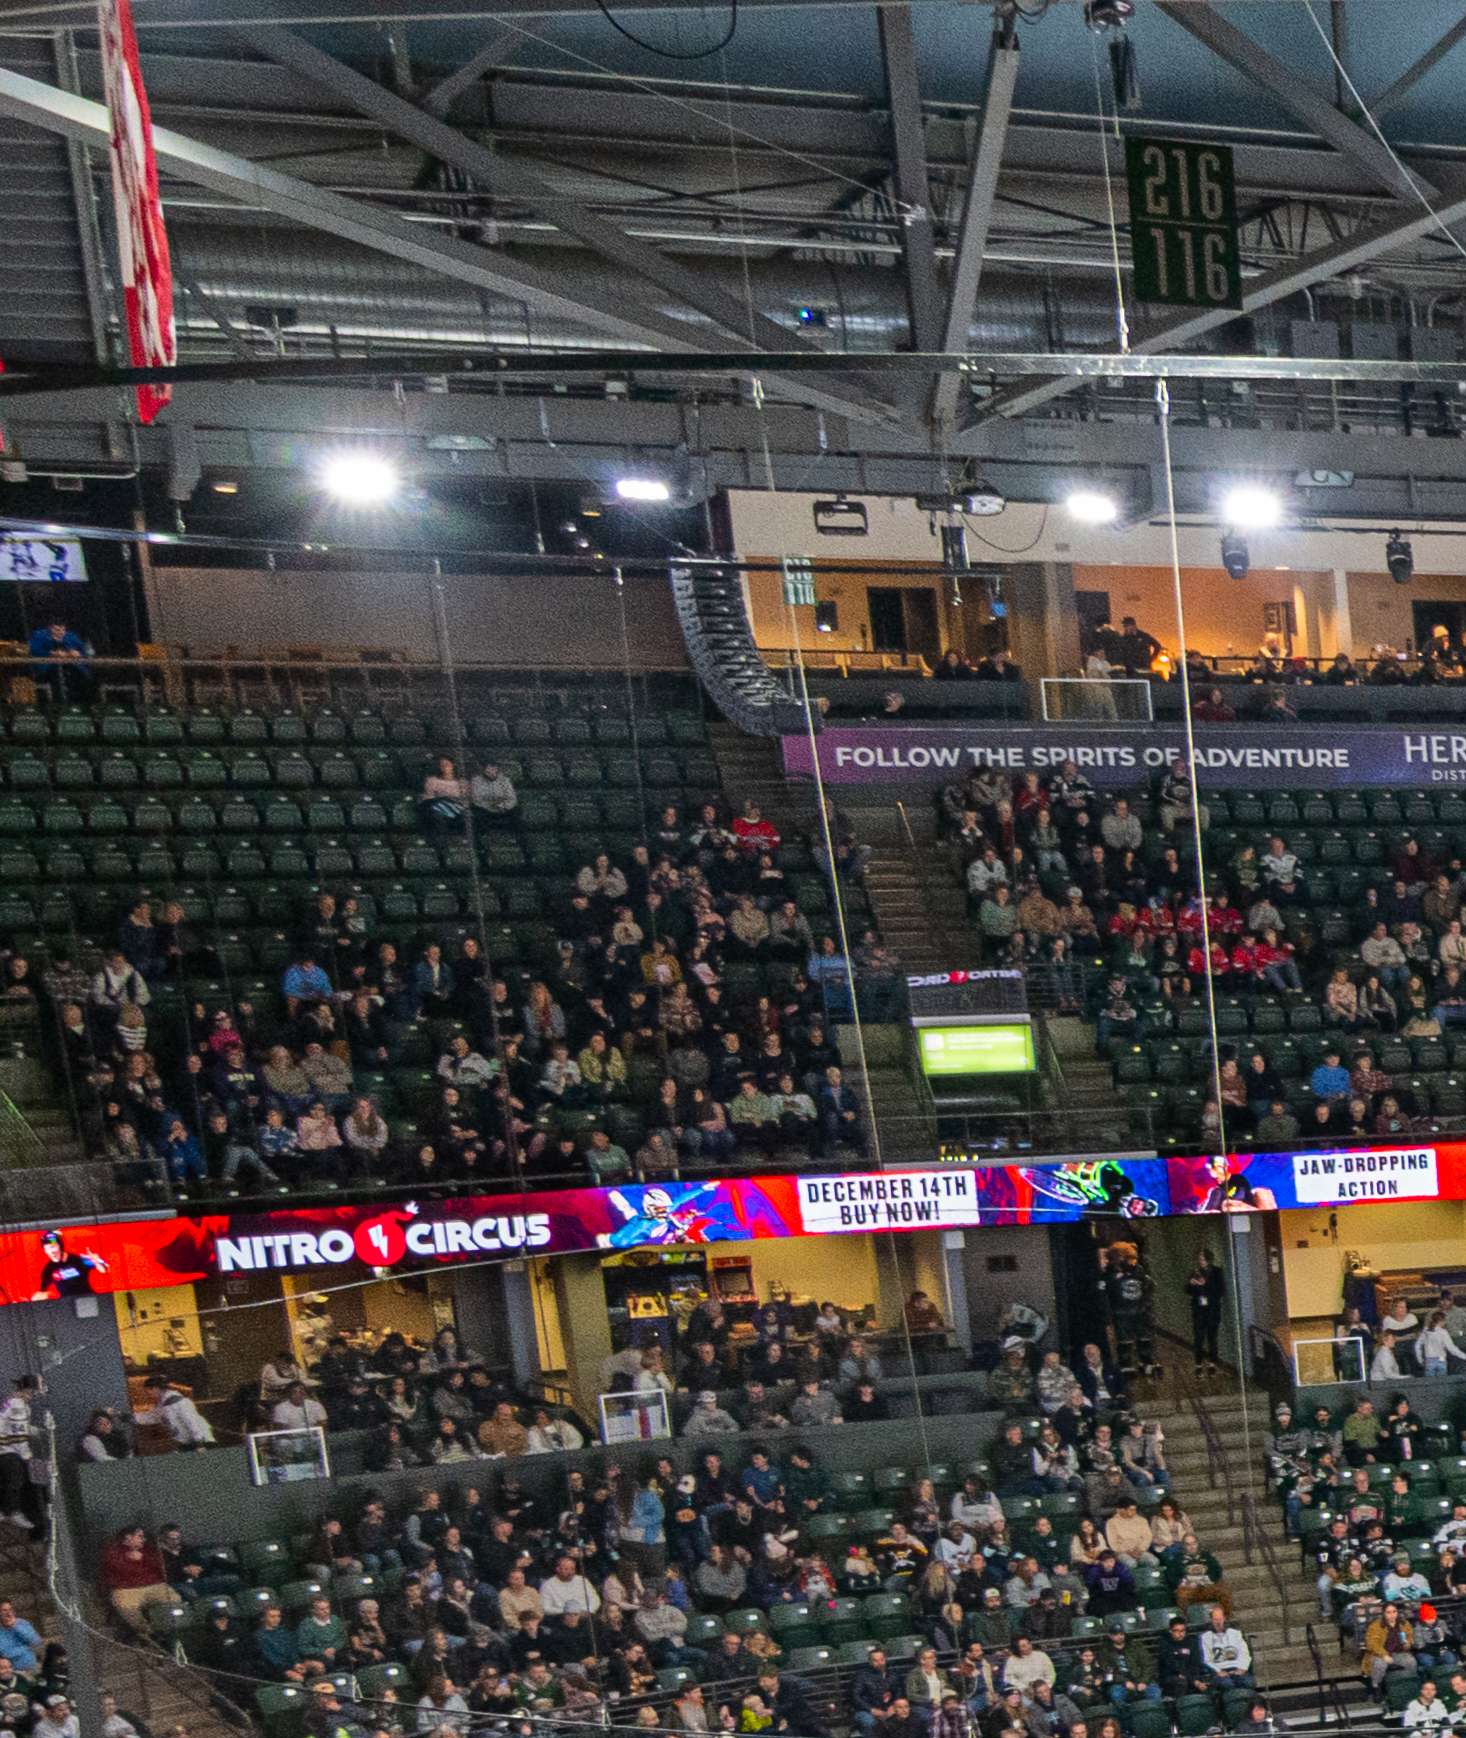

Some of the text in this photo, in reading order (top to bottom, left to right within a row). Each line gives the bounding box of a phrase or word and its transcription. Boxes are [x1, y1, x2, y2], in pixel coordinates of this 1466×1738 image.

[1144, 146, 1223, 220] 216
[1151, 228, 1229, 301] 116
[835, 745, 1350, 768] FOLLOW THE SPIRITS OF ADVENTURE
[1299, 1154, 1429, 1177] JAW-DROPPING
[807, 1175, 968, 1204] DECEMBER 14TH
[1337, 1178, 1398, 1198] ACTION
[840, 1201, 942, 1226] BUY NOW!
[217, 1213, 551, 1273] NITRO CIRCUS
